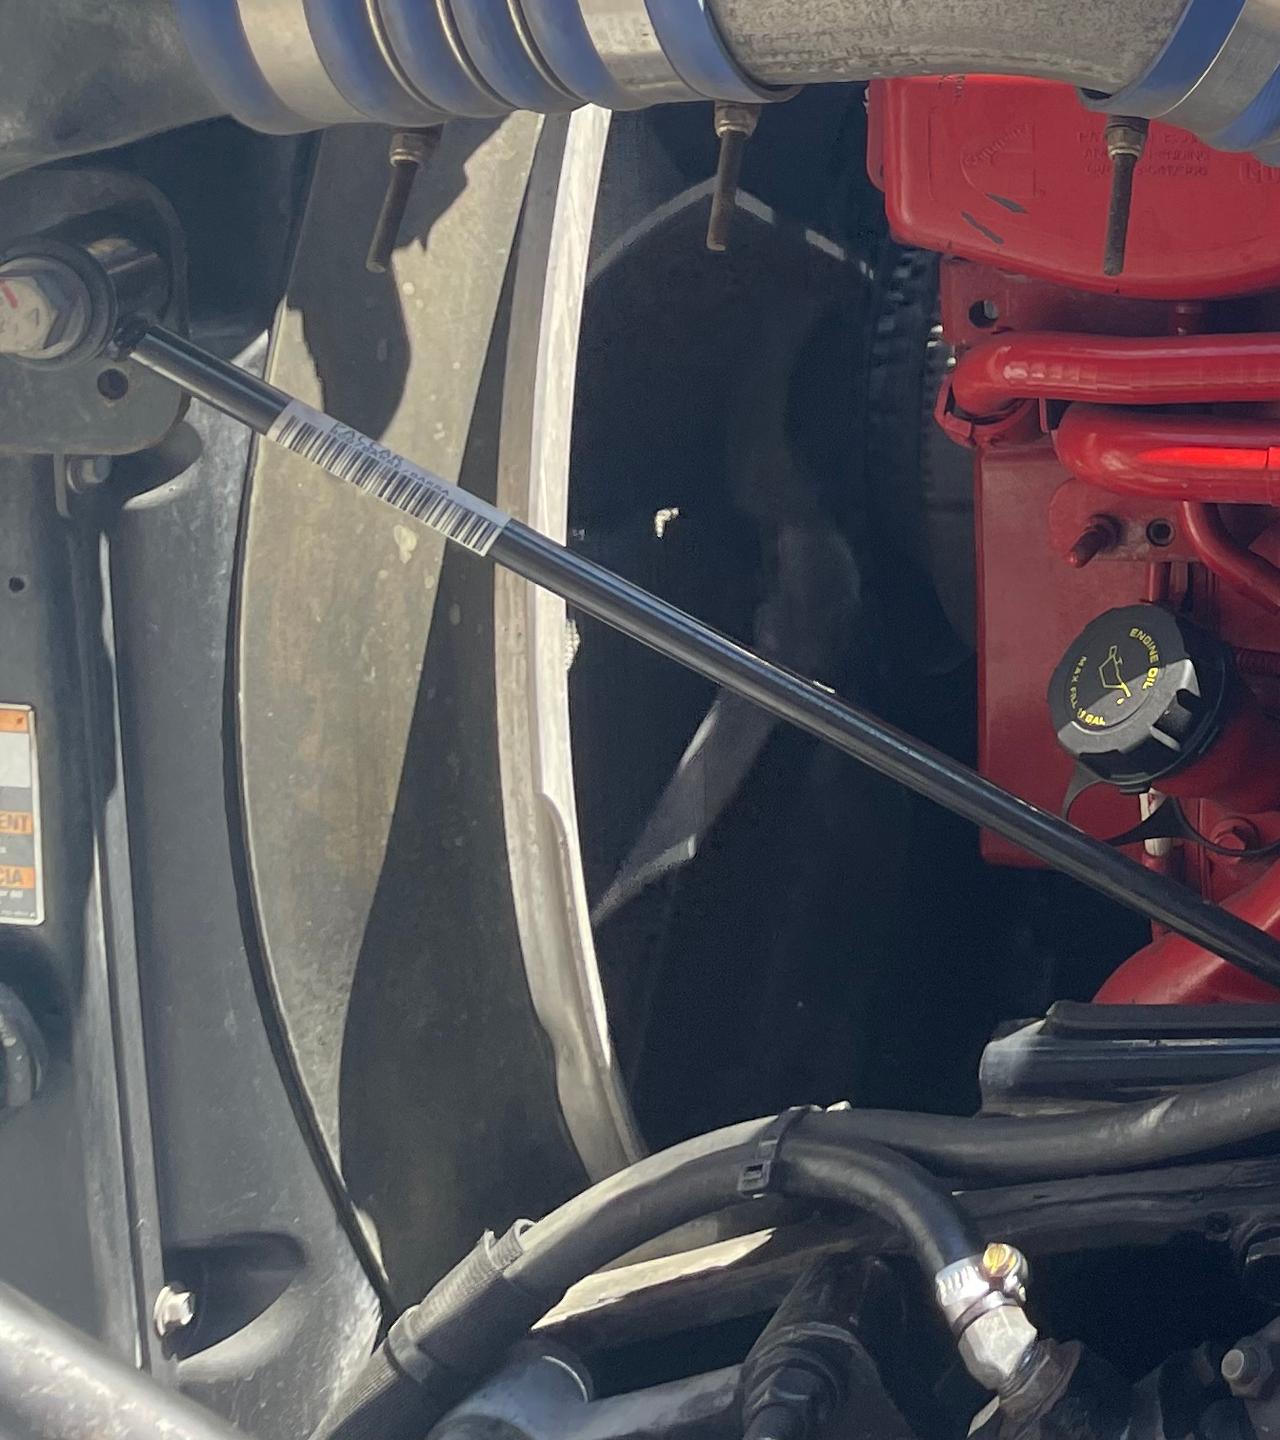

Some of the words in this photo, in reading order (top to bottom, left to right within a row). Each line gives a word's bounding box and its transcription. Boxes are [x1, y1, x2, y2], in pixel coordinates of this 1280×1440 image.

[1129, 628, 1160, 663] ENGINE
[1071, 656, 1087, 683] MAX
[1142, 667, 1159, 690] OIL
[1070, 687, 1078, 709] FILL
